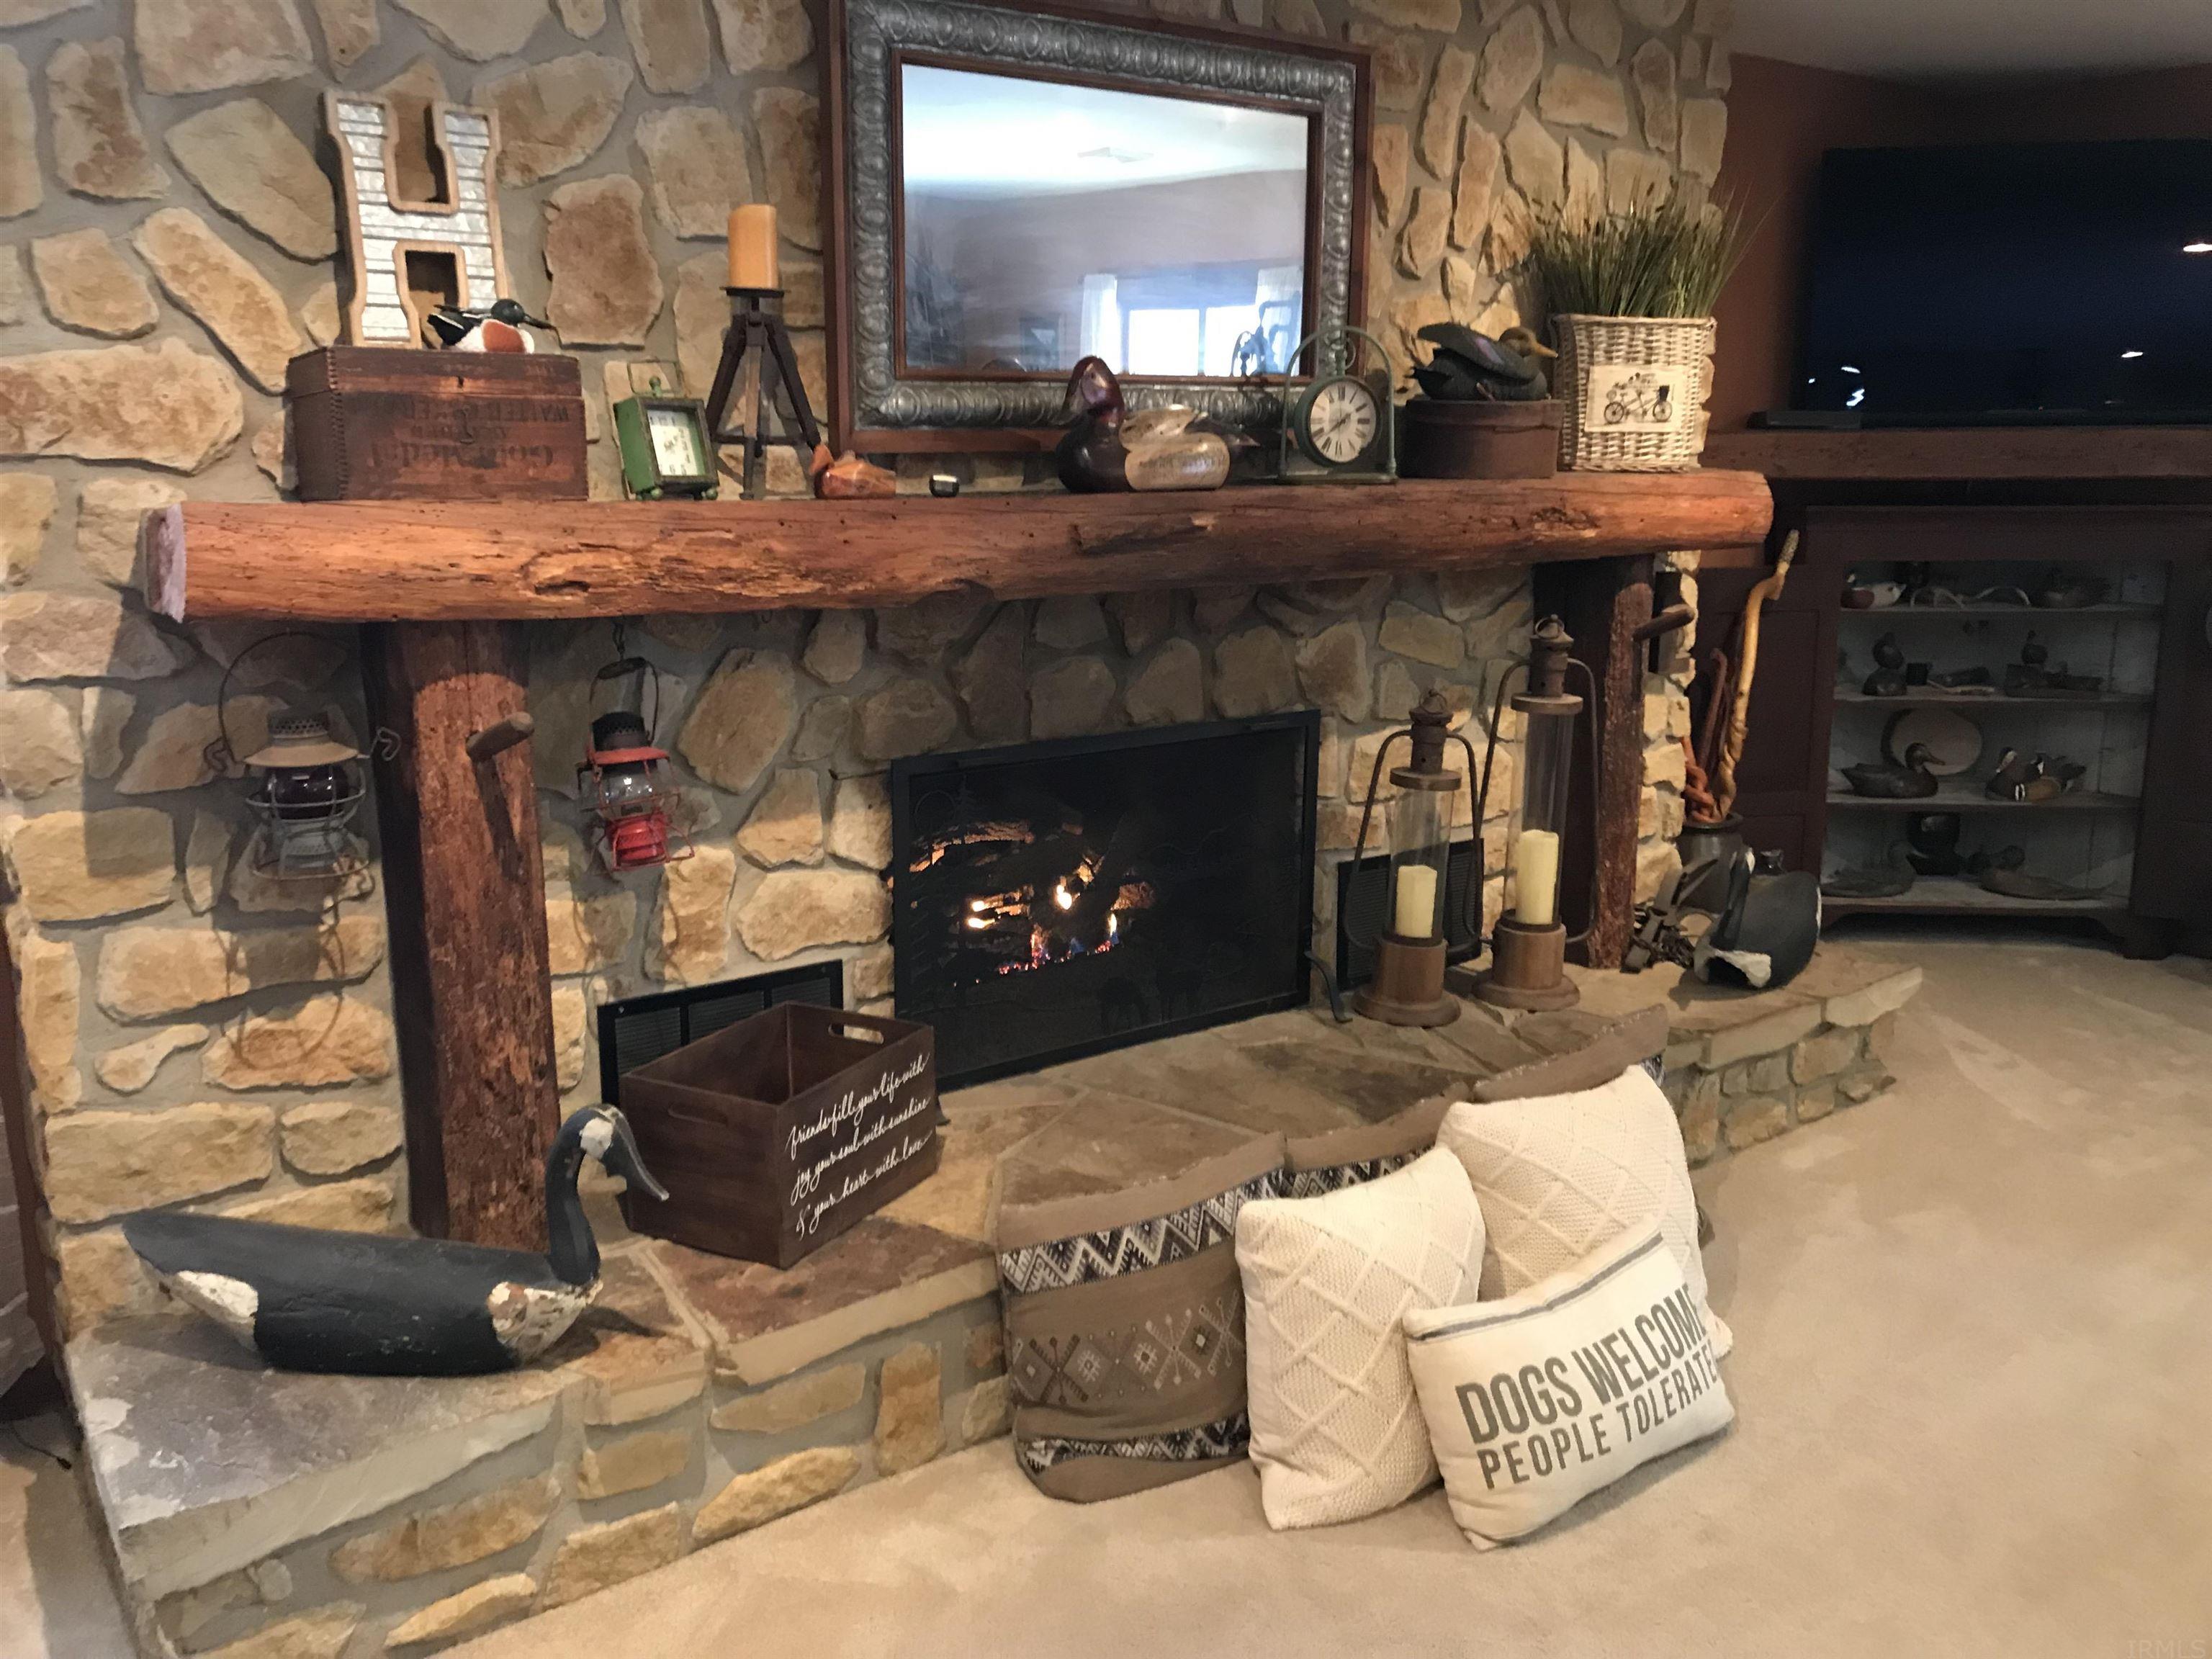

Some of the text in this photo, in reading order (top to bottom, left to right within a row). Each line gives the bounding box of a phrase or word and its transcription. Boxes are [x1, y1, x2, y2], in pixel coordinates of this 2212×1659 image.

[828, 1090, 856, 1138] fill
[854, 1088, 879, 1126] your
[878, 1071, 902, 1103] life
[902, 1053, 931, 1084] with
[809, 1151, 837, 1192] your
[835, 1126, 860, 1161] soul
[860, 1115, 887, 1146] with
[809, 1192, 837, 1235] your
[837, 1169, 871, 1200] heart
[873, 1146, 900, 1178] with
[899, 1130, 933, 1161] love
[1455, 1357, 1583, 1444] DOGS
[1476, 1339, 1718, 1491] PEOPLE TOLERATE
